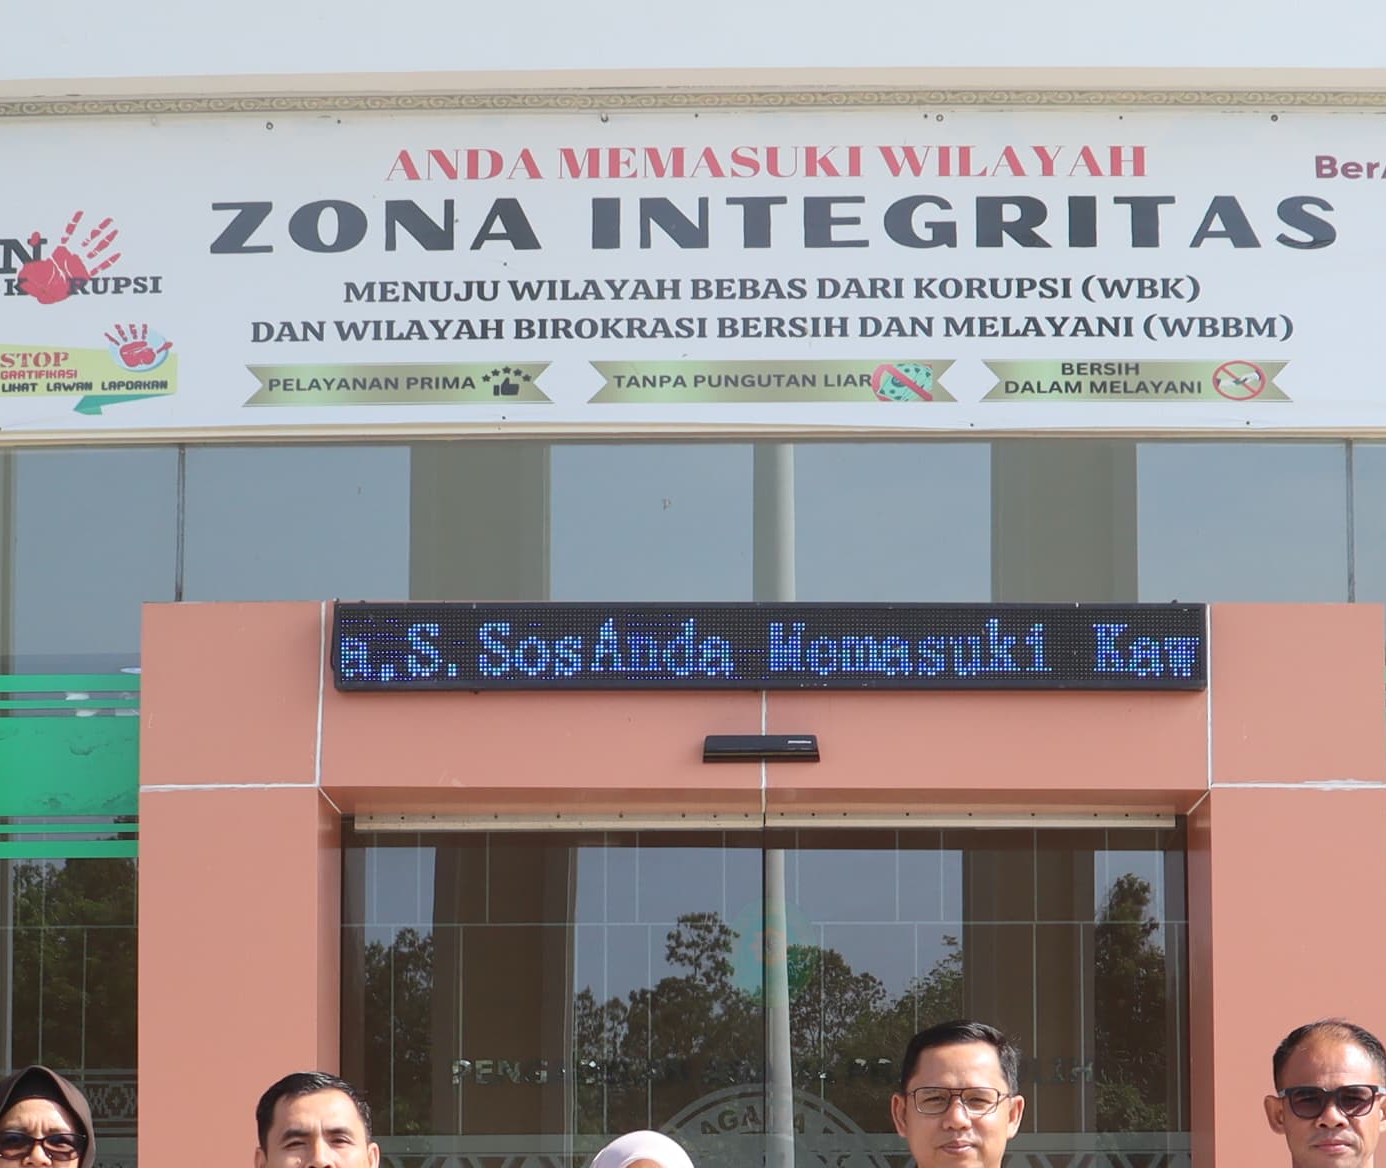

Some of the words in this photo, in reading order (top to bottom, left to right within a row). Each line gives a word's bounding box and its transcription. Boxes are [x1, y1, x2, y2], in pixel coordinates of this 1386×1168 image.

[385, 149, 544, 181] ANDA
[557, 146, 863, 180] MEMASUKI
[878, 145, 1149, 178] WILAYAH
[210, 198, 542, 254] ZONA
[591, 194, 1337, 250] INTEGRITAS
[343, 280, 501, 303] MENUJU
[507, 278, 682, 301] WILAYAH
[690, 277, 807, 300] BEBAS
[816, 277, 904, 300] DARI
[913, 276, 1073, 300] KORUPSI
[1081, 275, 1201, 303] (WBK)
[250, 320, 327, 343] DAN
[334, 318, 505, 342] WILAYAH
[513, 317, 708, 340] BIROKRASI
[716, 315, 850, 339] BERSIH
[858, 315, 935, 338] DAN
[942, 315, 1133, 338] MELAYANI
[1143, 313, 1295, 342] (WBBM)
[0, 352, 69, 368] STOP
[0, 369, 78, 380] GRATIFIKASI
[1061, 362, 1140, 376] BERSIH
[2, 382, 38, 393] LIHAT
[46, 381, 93, 392] LAWAN
[101, 380, 168, 391] LAPORKAN
[268, 376, 400, 392] PELAYANAN
[406, 375, 476, 391] PRIMA
[614, 373, 688, 389] TANPA
[693, 373, 817, 389] PUNGUTAN
[823, 372, 872, 388] LIAR
[1004, 379, 1083, 395] DALAM
[1089, 379, 1203, 395] MELAYANI
